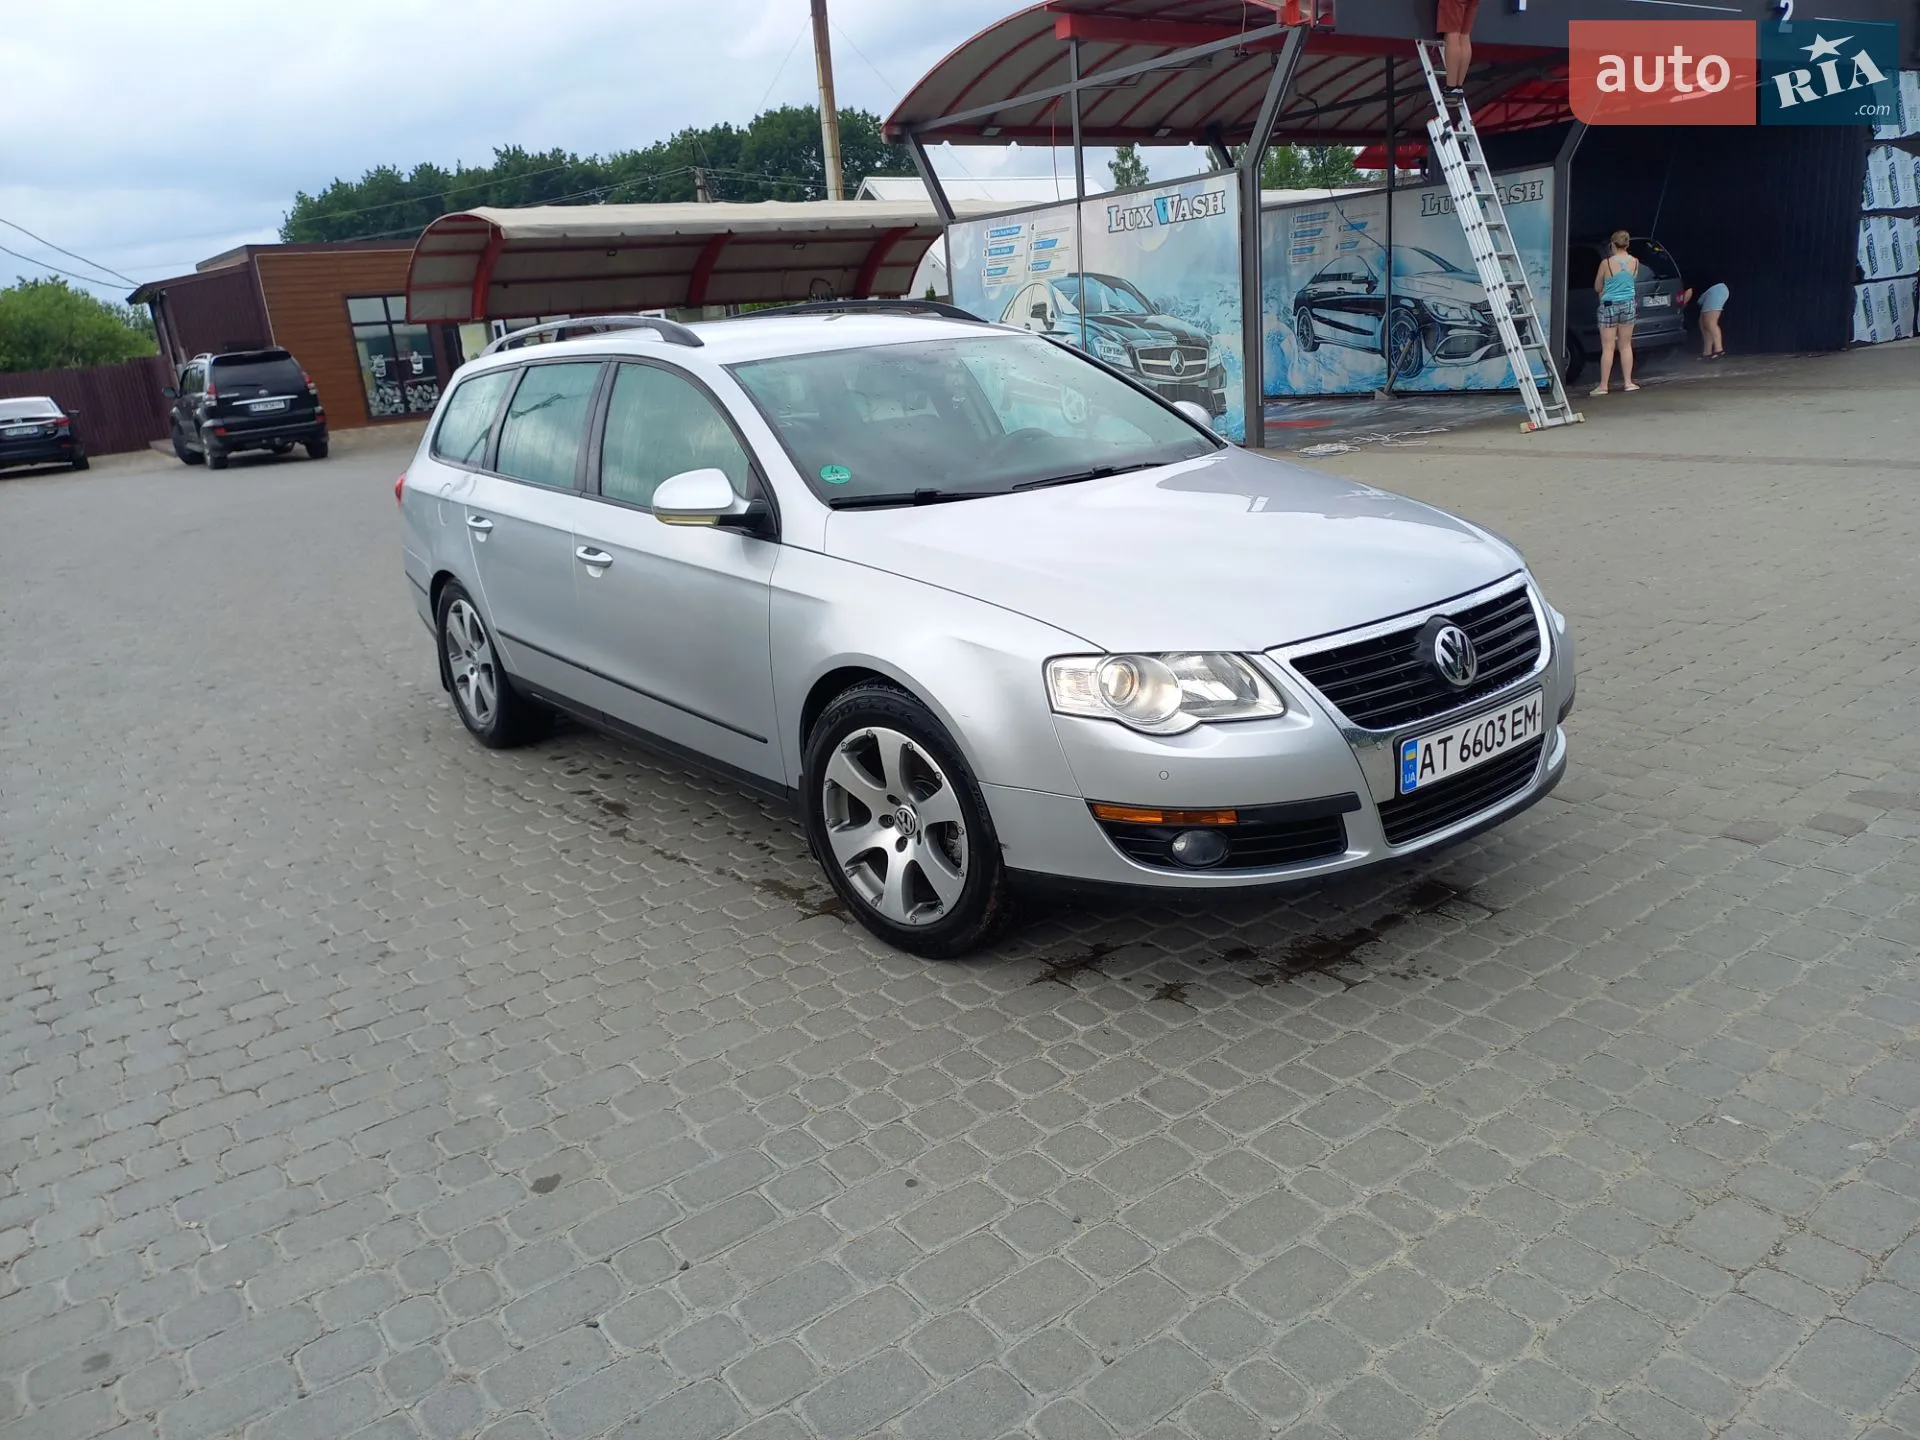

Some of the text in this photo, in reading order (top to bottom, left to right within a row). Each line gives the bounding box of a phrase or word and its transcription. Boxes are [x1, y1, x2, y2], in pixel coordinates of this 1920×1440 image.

[1777, 0, 1794, 33] 2
[1107, 190, 1226, 234] LUX WASH
[1421, 180, 1544, 217] LU ASH
[1404, 699, 1537, 785] UA AT 6603 EM
